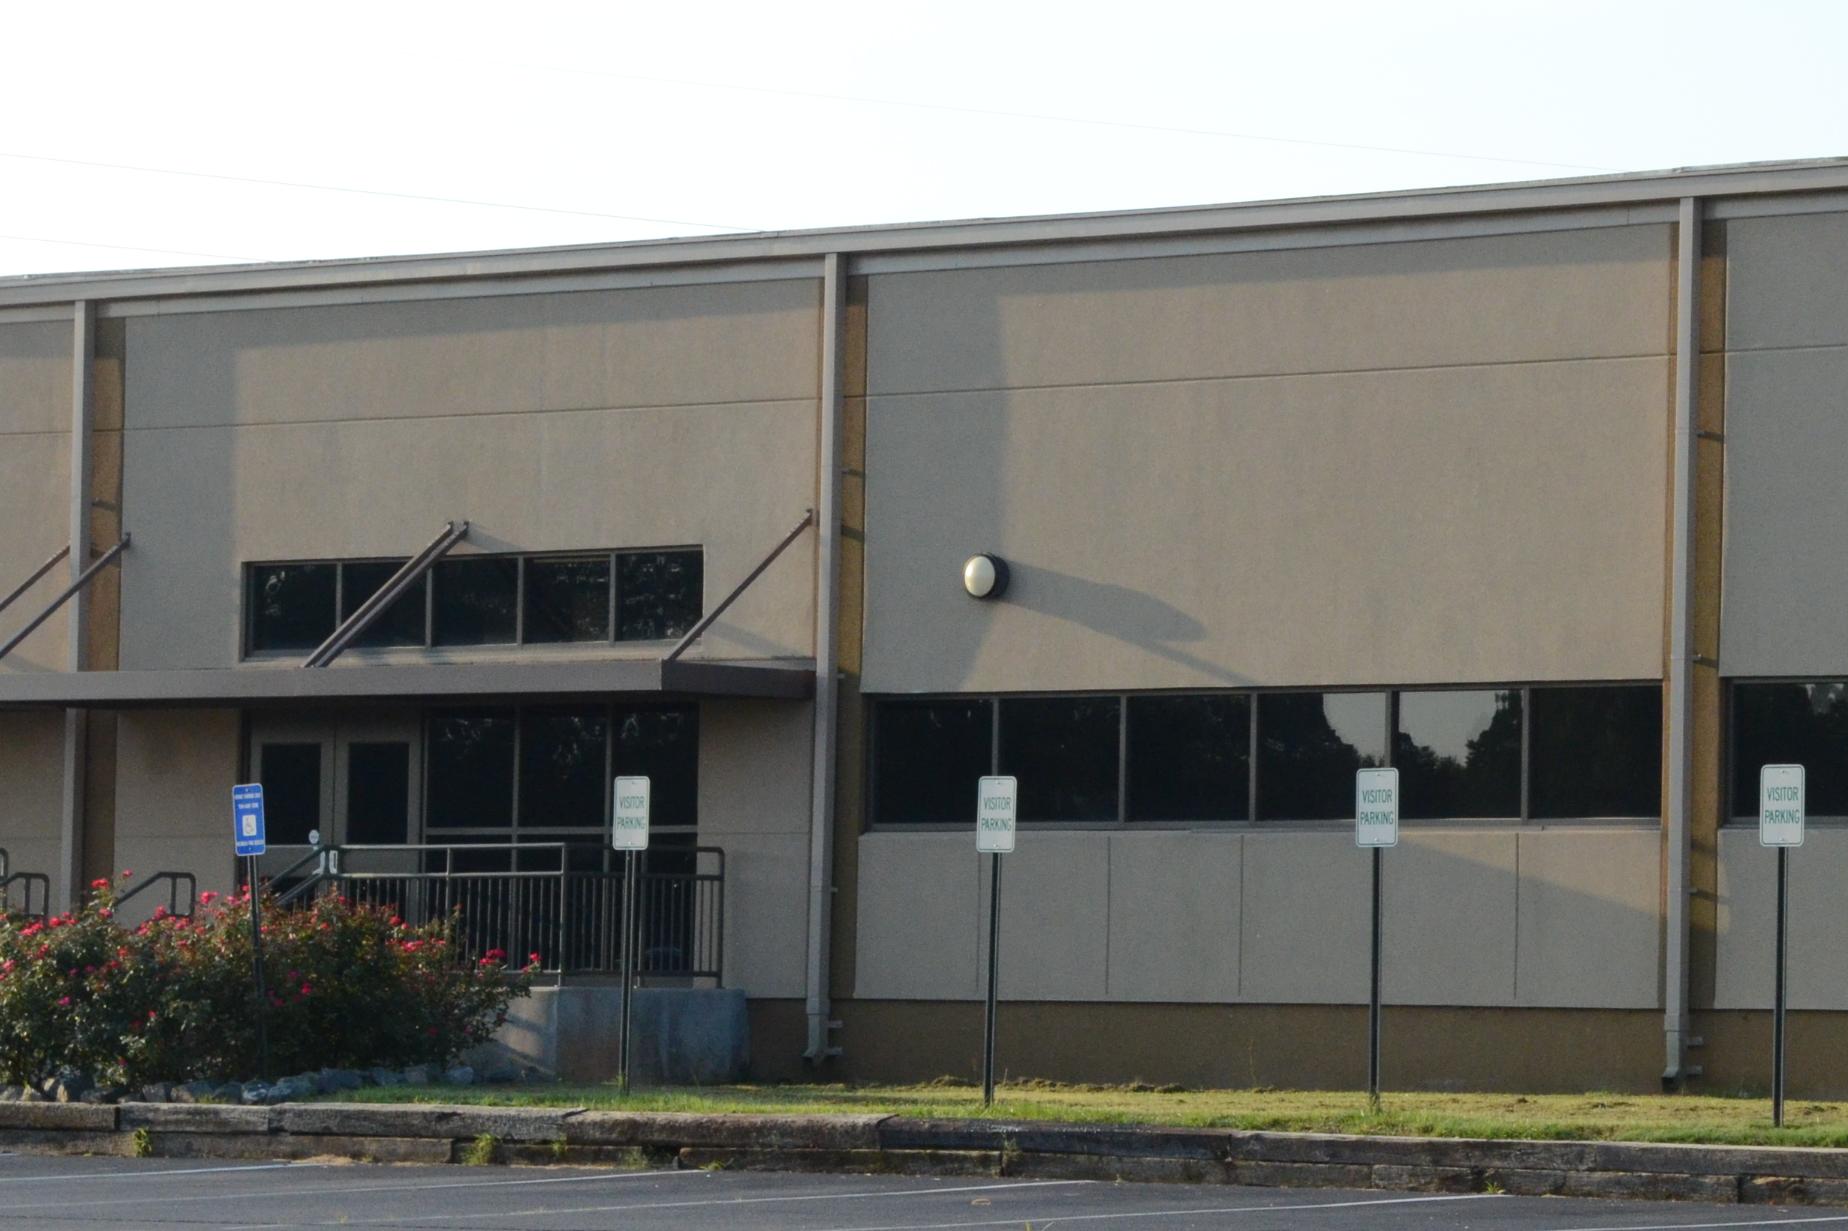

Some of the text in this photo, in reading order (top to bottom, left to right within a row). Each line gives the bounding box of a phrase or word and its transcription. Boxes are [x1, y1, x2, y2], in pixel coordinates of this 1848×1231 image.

[1362, 789, 1393, 804] VISITOR
[1767, 786, 1799, 801] VISITOR
[619, 795, 646, 809] VISITOR
[984, 796, 1011, 810] VISITOR
[616, 815, 646, 831] PARKING
[981, 816, 1012, 832] PARKING
[1360, 811, 1393, 825] PARKING
[1764, 809, 1800, 825] PARKING
